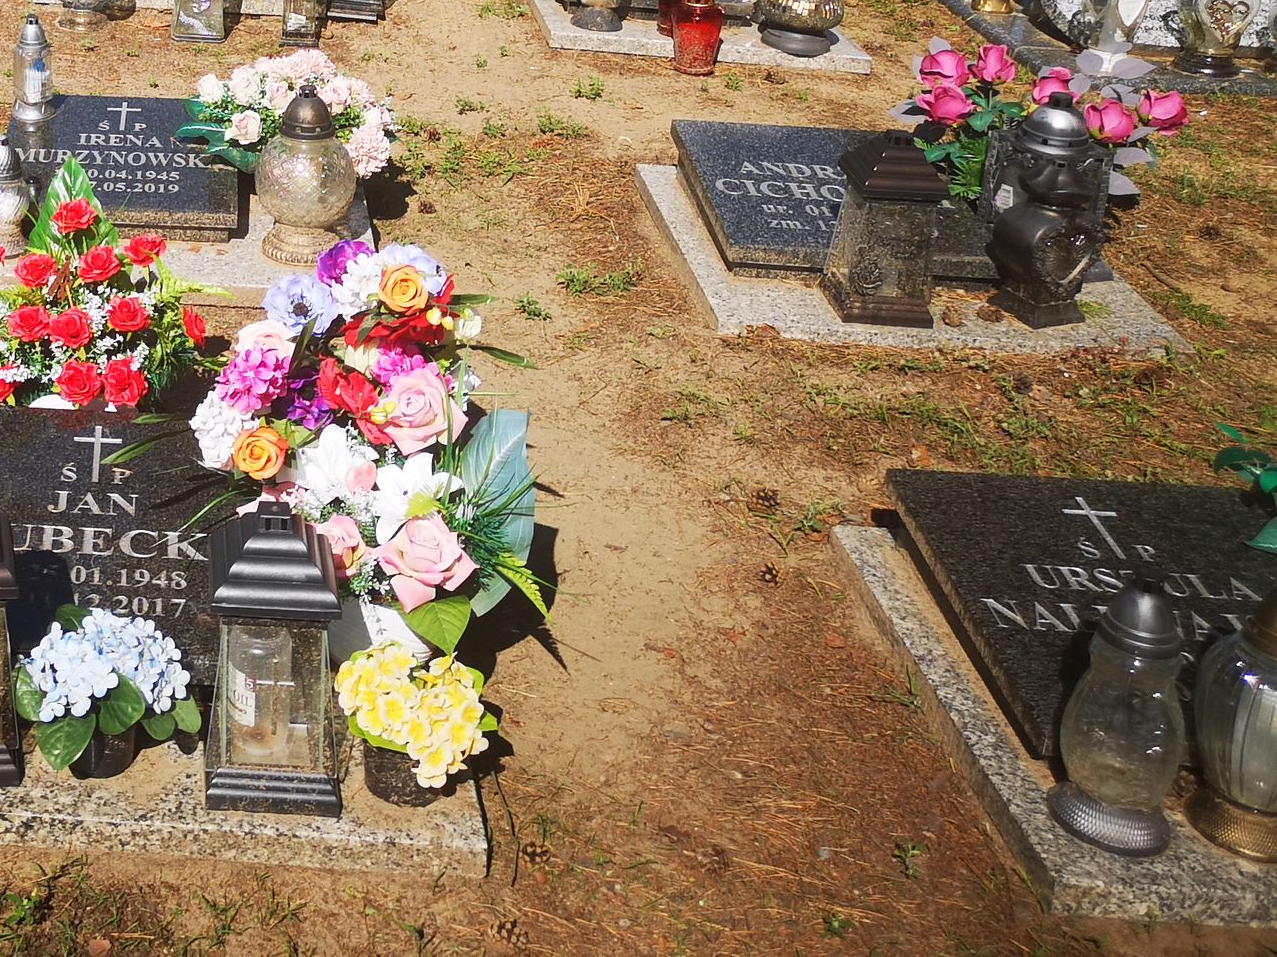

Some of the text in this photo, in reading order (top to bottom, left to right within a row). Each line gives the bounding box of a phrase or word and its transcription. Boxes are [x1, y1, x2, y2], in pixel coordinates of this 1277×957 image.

[131, 122, 147, 133] P
[76, 132, 164, 149] IRENA
[14, 147, 213, 170] MURZYNOWSK
[87, 168, 181, 182] 0.04.1945
[738, 160, 848, 180] ANDR
[89, 180, 180, 194] 7.05.2019
[714, 178, 846, 202] CICHO
[760, 204, 794, 215] ur.
[60, 461, 135, 485] Ś P
[46, 490, 140, 518] JAN
[10, 523, 210, 562] UBECK
[1130, 544, 1156, 563] P
